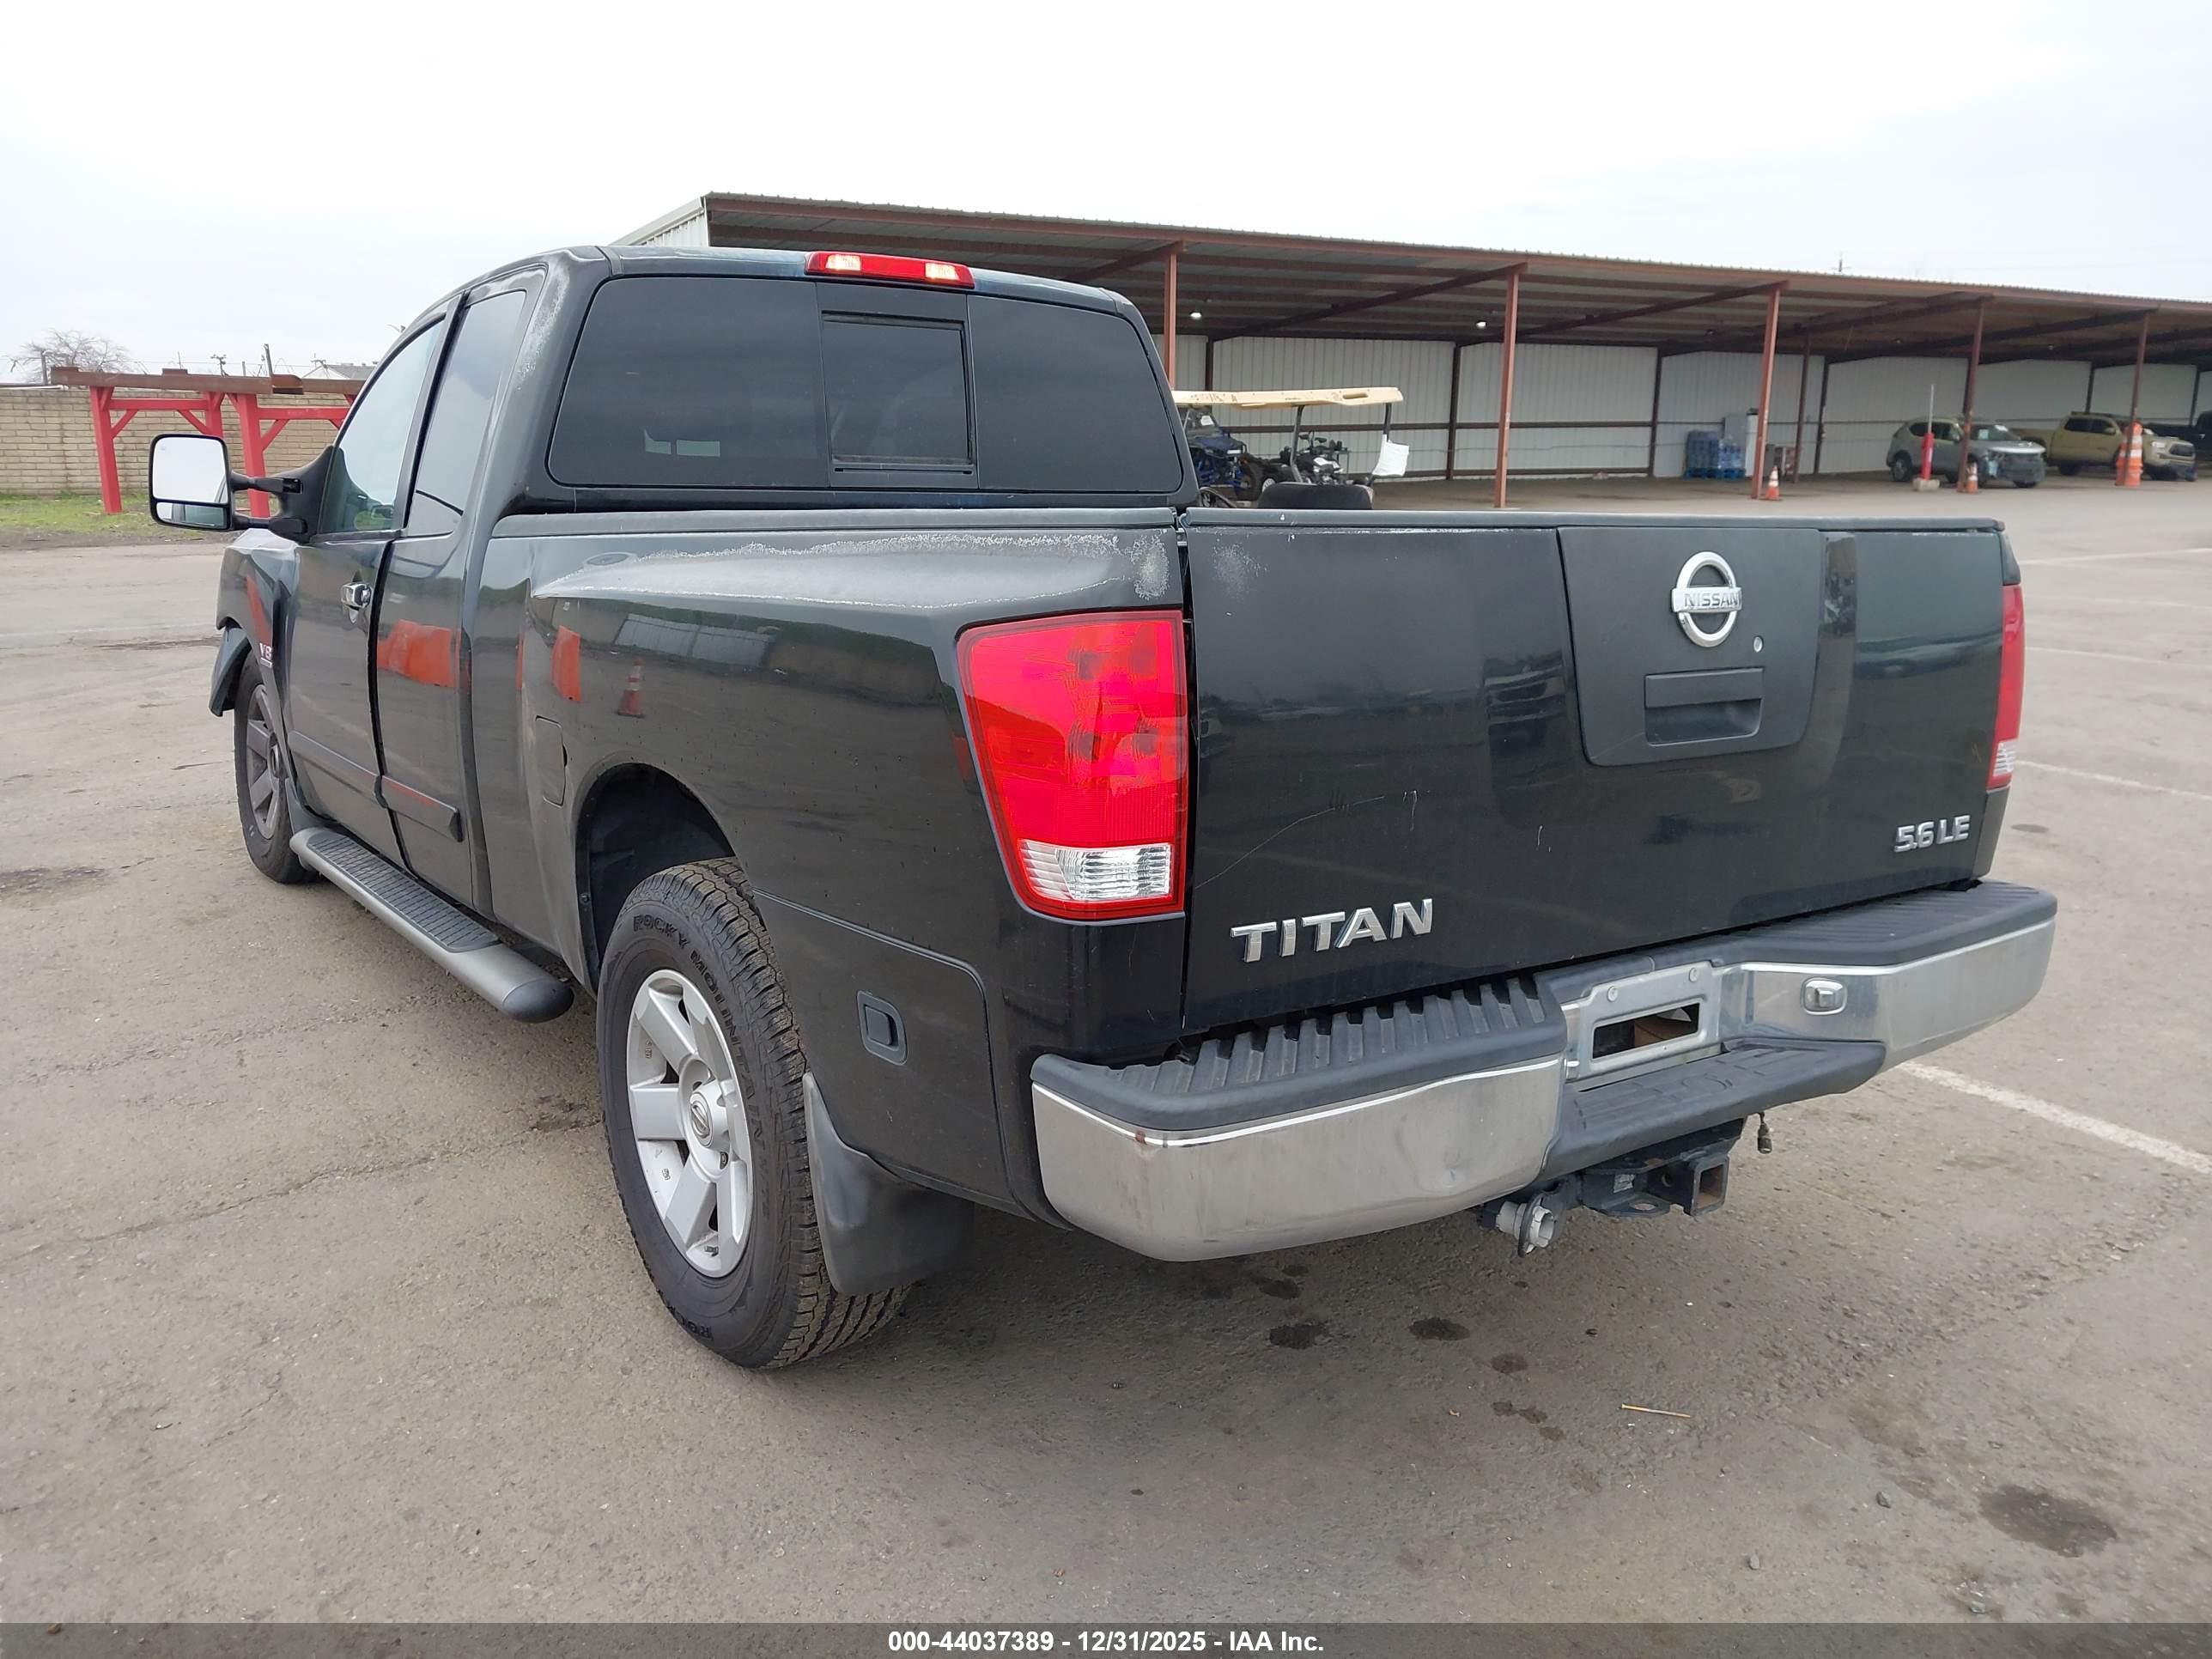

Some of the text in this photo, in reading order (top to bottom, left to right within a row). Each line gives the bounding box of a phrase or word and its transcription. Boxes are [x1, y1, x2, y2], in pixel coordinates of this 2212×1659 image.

[1684, 592, 1740, 606] NISSAN
[259, 642, 272, 660] V8
[1936, 814, 1970, 844] LE
[633, 914, 690, 949] ROCKY
[1231, 898, 1433, 963] TITAN
